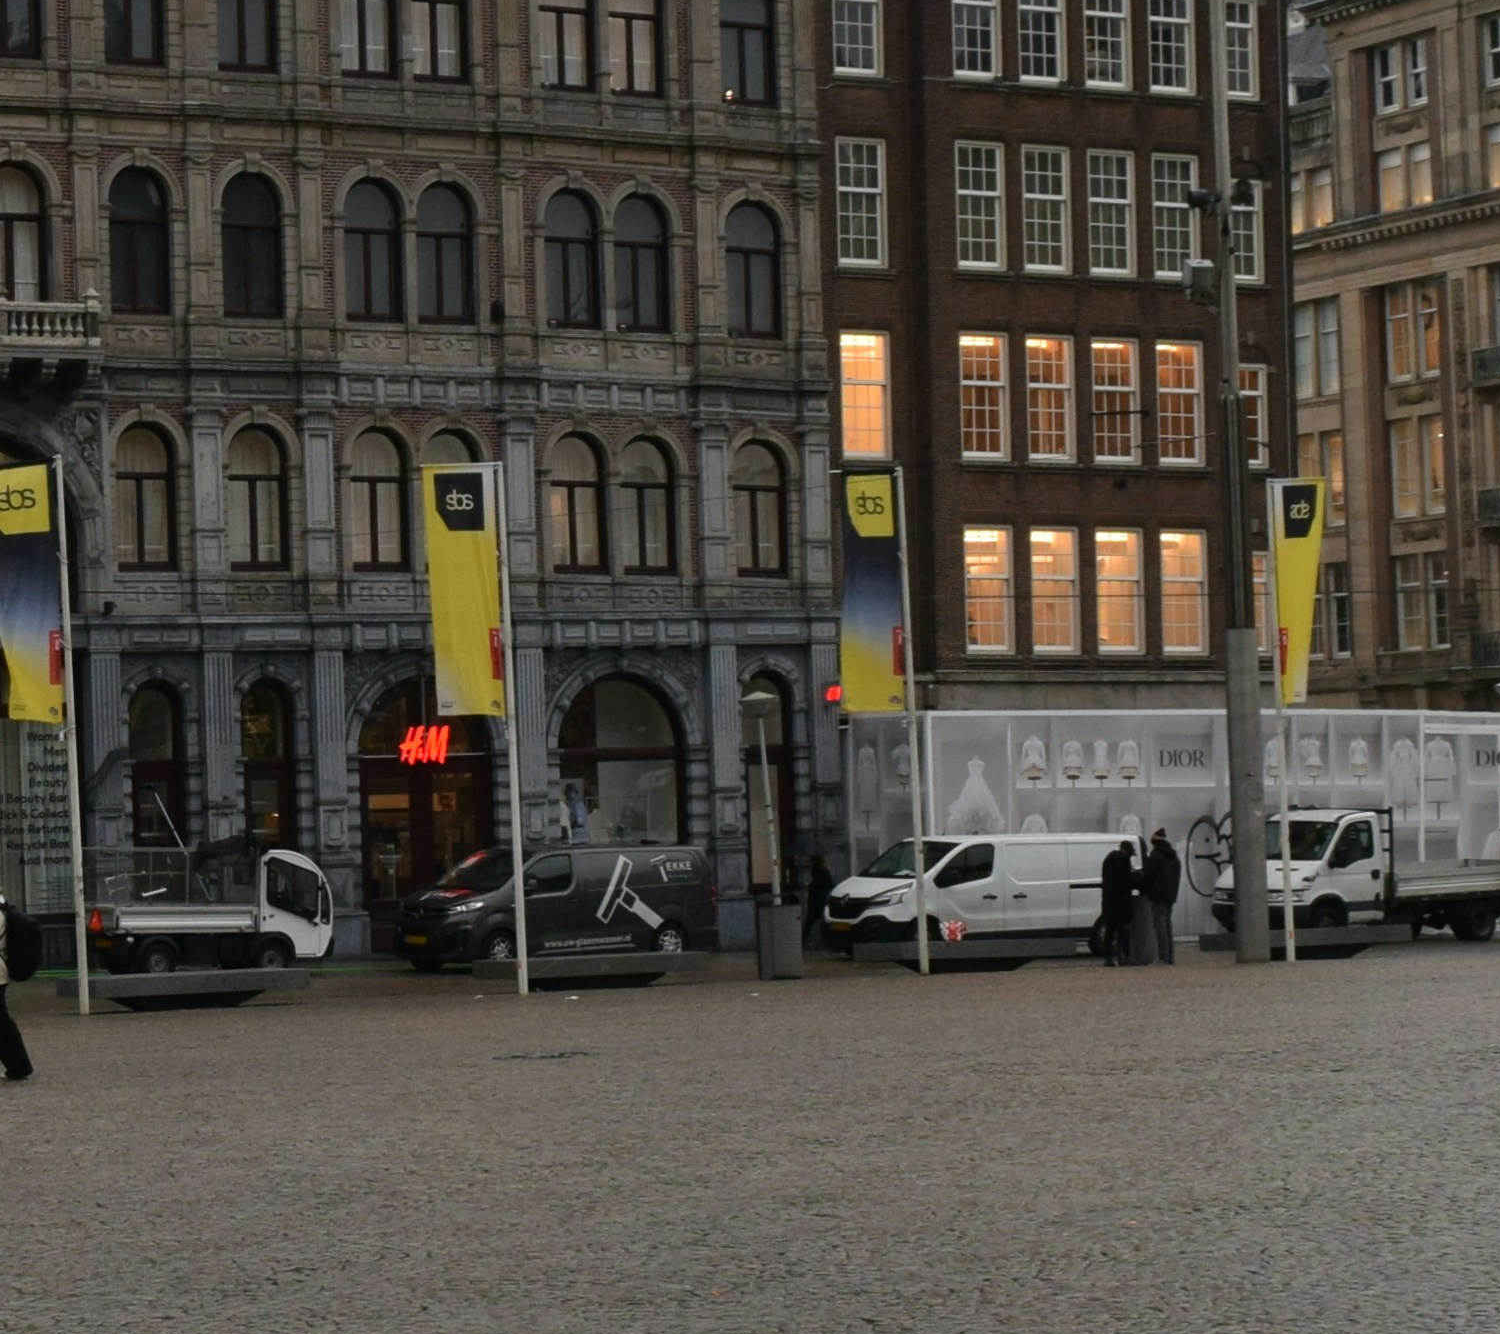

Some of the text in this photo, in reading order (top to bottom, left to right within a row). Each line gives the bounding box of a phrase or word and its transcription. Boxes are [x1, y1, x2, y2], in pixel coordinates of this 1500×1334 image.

[43, 745, 67, 756] Men
[399, 724, 449, 766] H&M
[1159, 749, 1205, 768] DIOR
[27, 760, 68, 772] Divided
[29, 778, 67, 790] Beauty
[6, 793, 46, 805] Beauty
[49, 792, 68, 803] Bar
[30, 807, 69, 819] Collect
[28, 823, 70, 834] Returns
[6, 838, 70, 851] Recycle Box
[18, 854, 71, 866] And more
